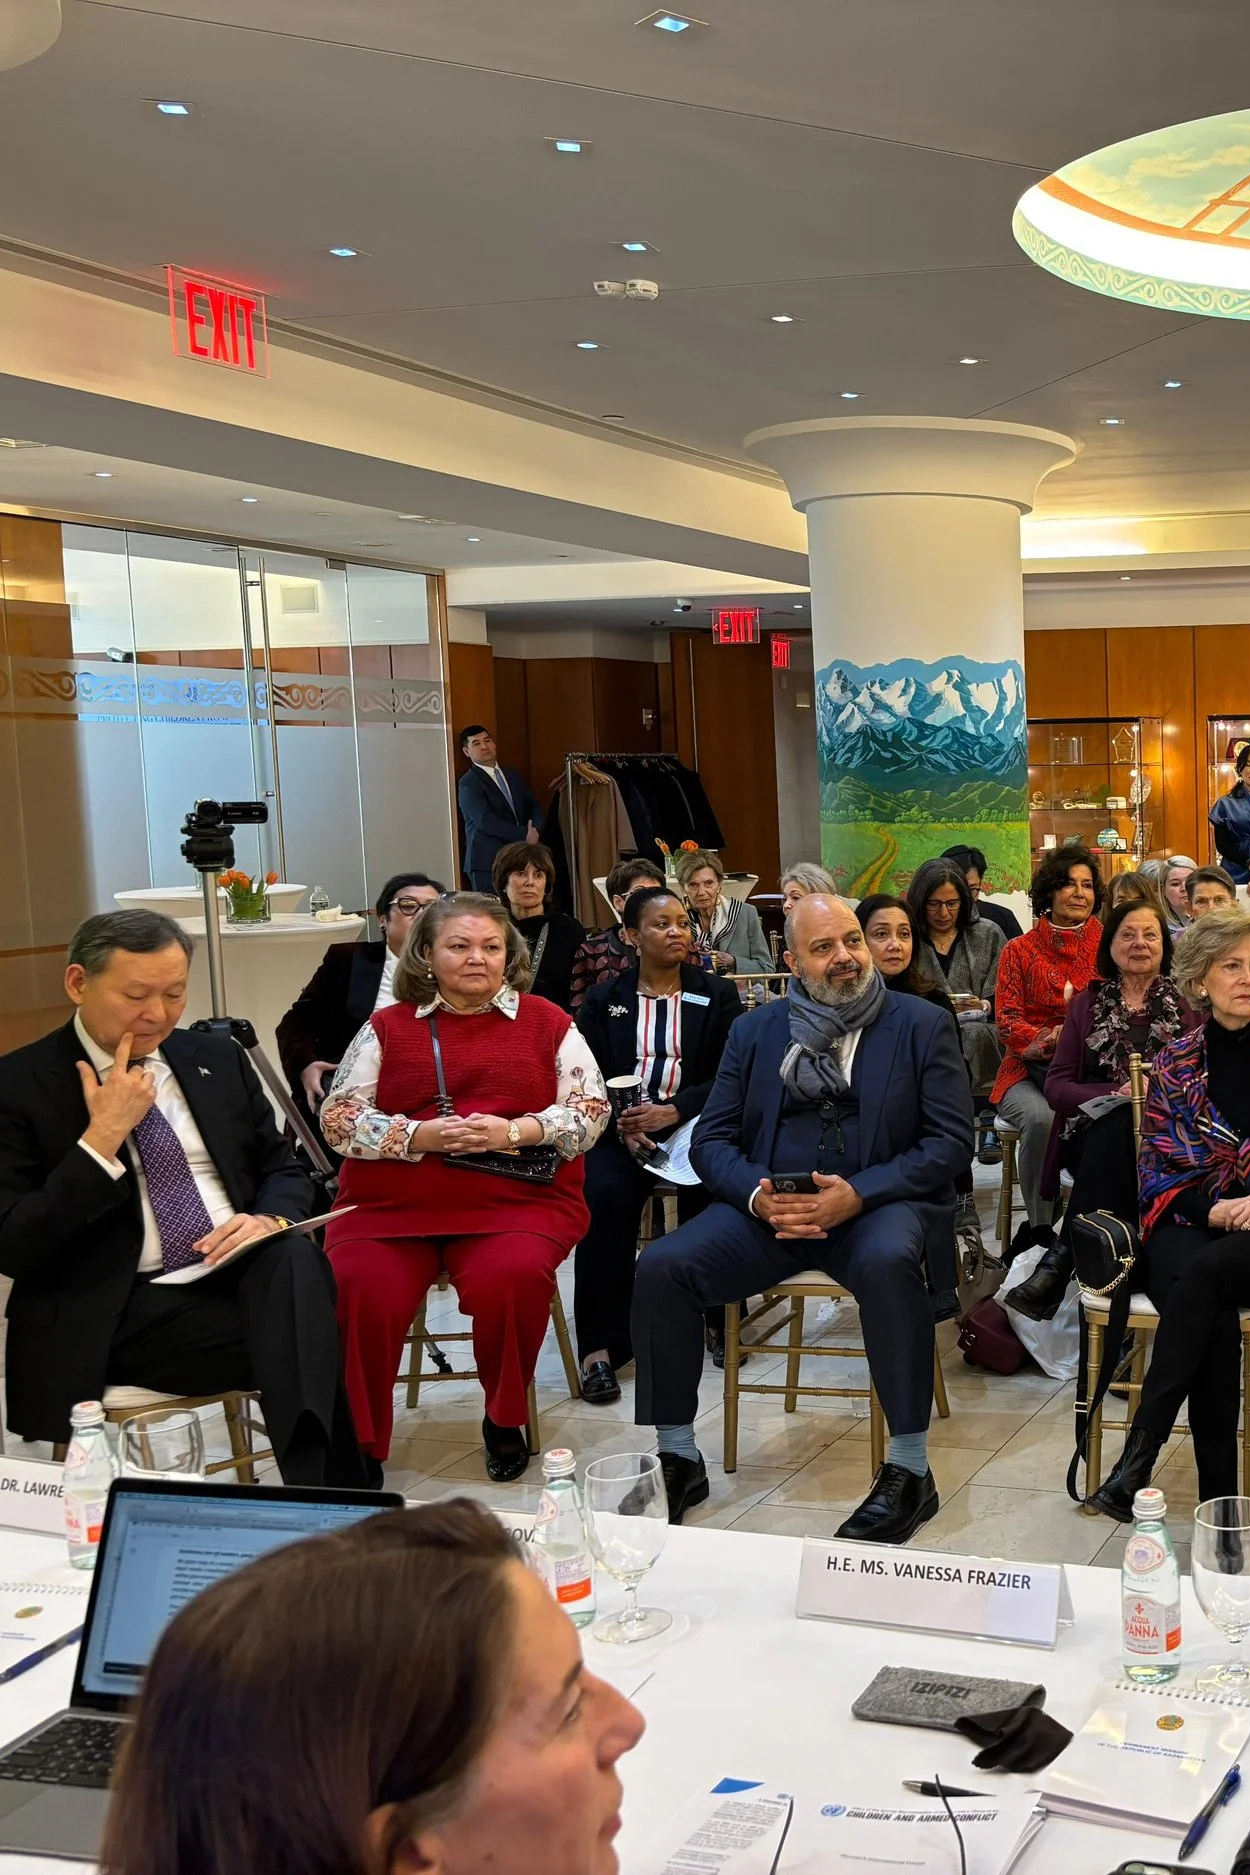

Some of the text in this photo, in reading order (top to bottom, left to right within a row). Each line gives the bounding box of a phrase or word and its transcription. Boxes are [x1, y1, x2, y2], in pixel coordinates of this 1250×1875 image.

[184, 280, 257, 370] EXIT
[719, 611, 755, 643] EXIT
[772, 640, 788, 668] EXIT
[1, 1478, 64, 1498] DR. LAWRE
[826, 1555, 1031, 1590] H.E. MS. VANESSA FRAZIER
[1124, 1619, 1159, 1638] PANNA
[910, 1682, 972, 1700] IZIPIZI
[846, 1810, 998, 1823] CHILDREN AND ARMED CONFLICT
